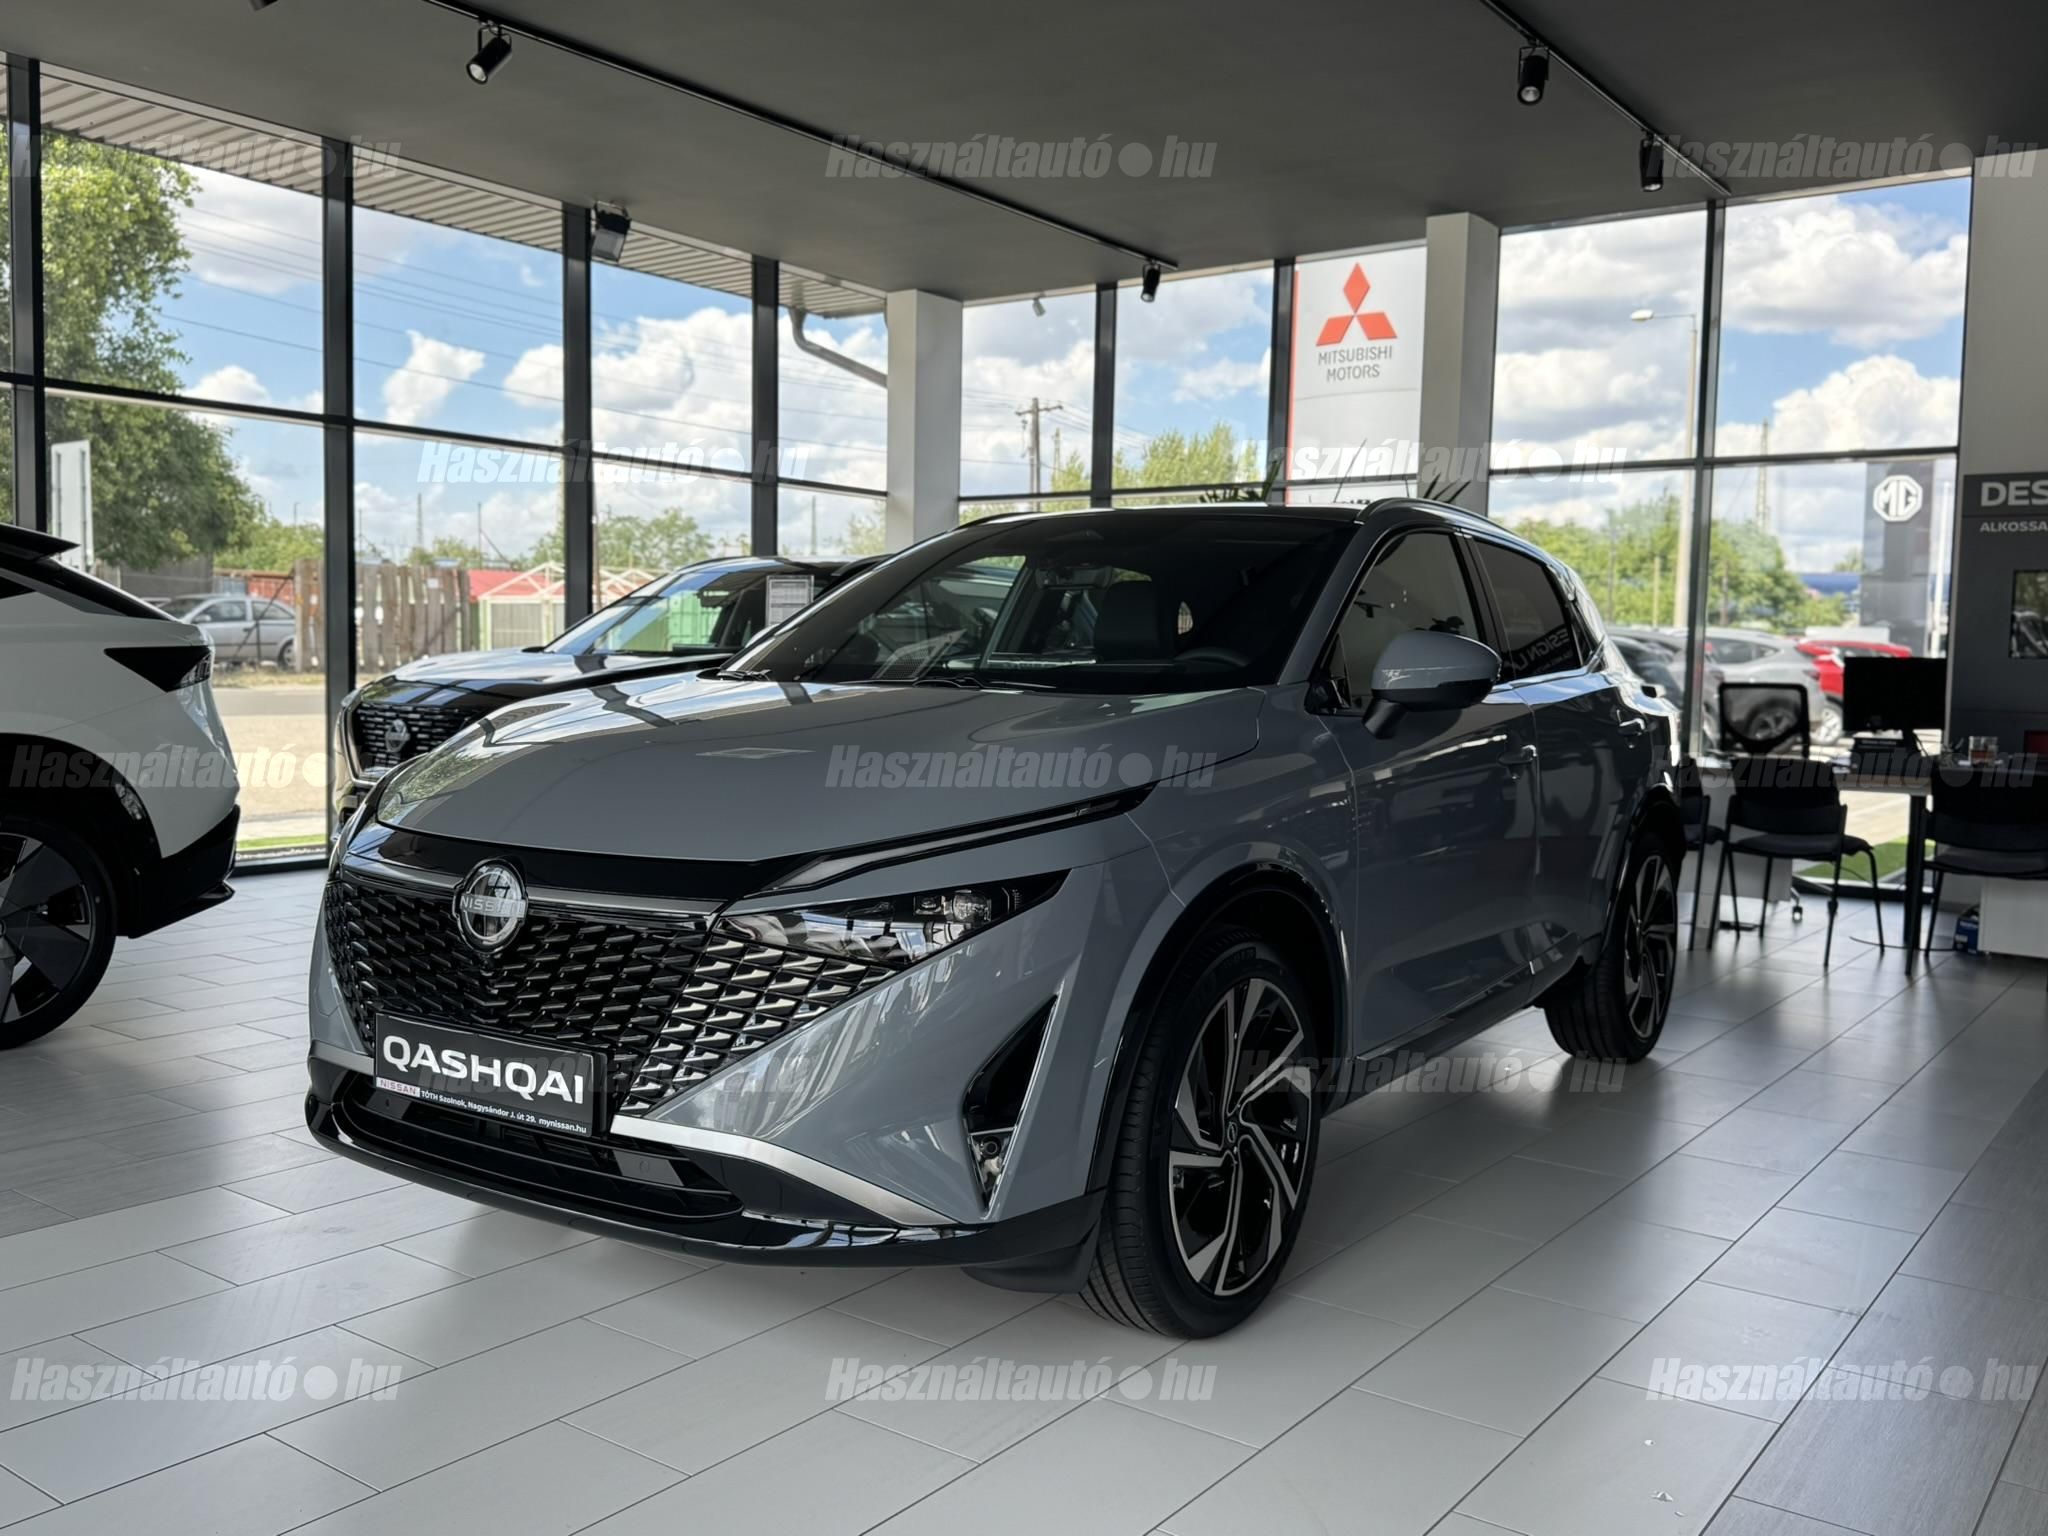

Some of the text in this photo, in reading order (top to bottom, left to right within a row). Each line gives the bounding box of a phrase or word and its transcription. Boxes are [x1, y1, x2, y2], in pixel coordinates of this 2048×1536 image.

[1318, 345, 1392, 365] MITSUBISHI
[1326, 363, 1380, 382] MOTORS
[1876, 478, 1920, 518] MG
[383, 1035, 584, 1104] QASHQAI
[379, 1079, 417, 1095] NISSAN
[439, 1094, 467, 1109] Szolnok,
[468, 1101, 509, 1117] Nagysándor
[517, 1112, 525, 1120] út
[526, 1114, 536, 1124] 29.
[538, 1118, 587, 1134] mynissan.hu
